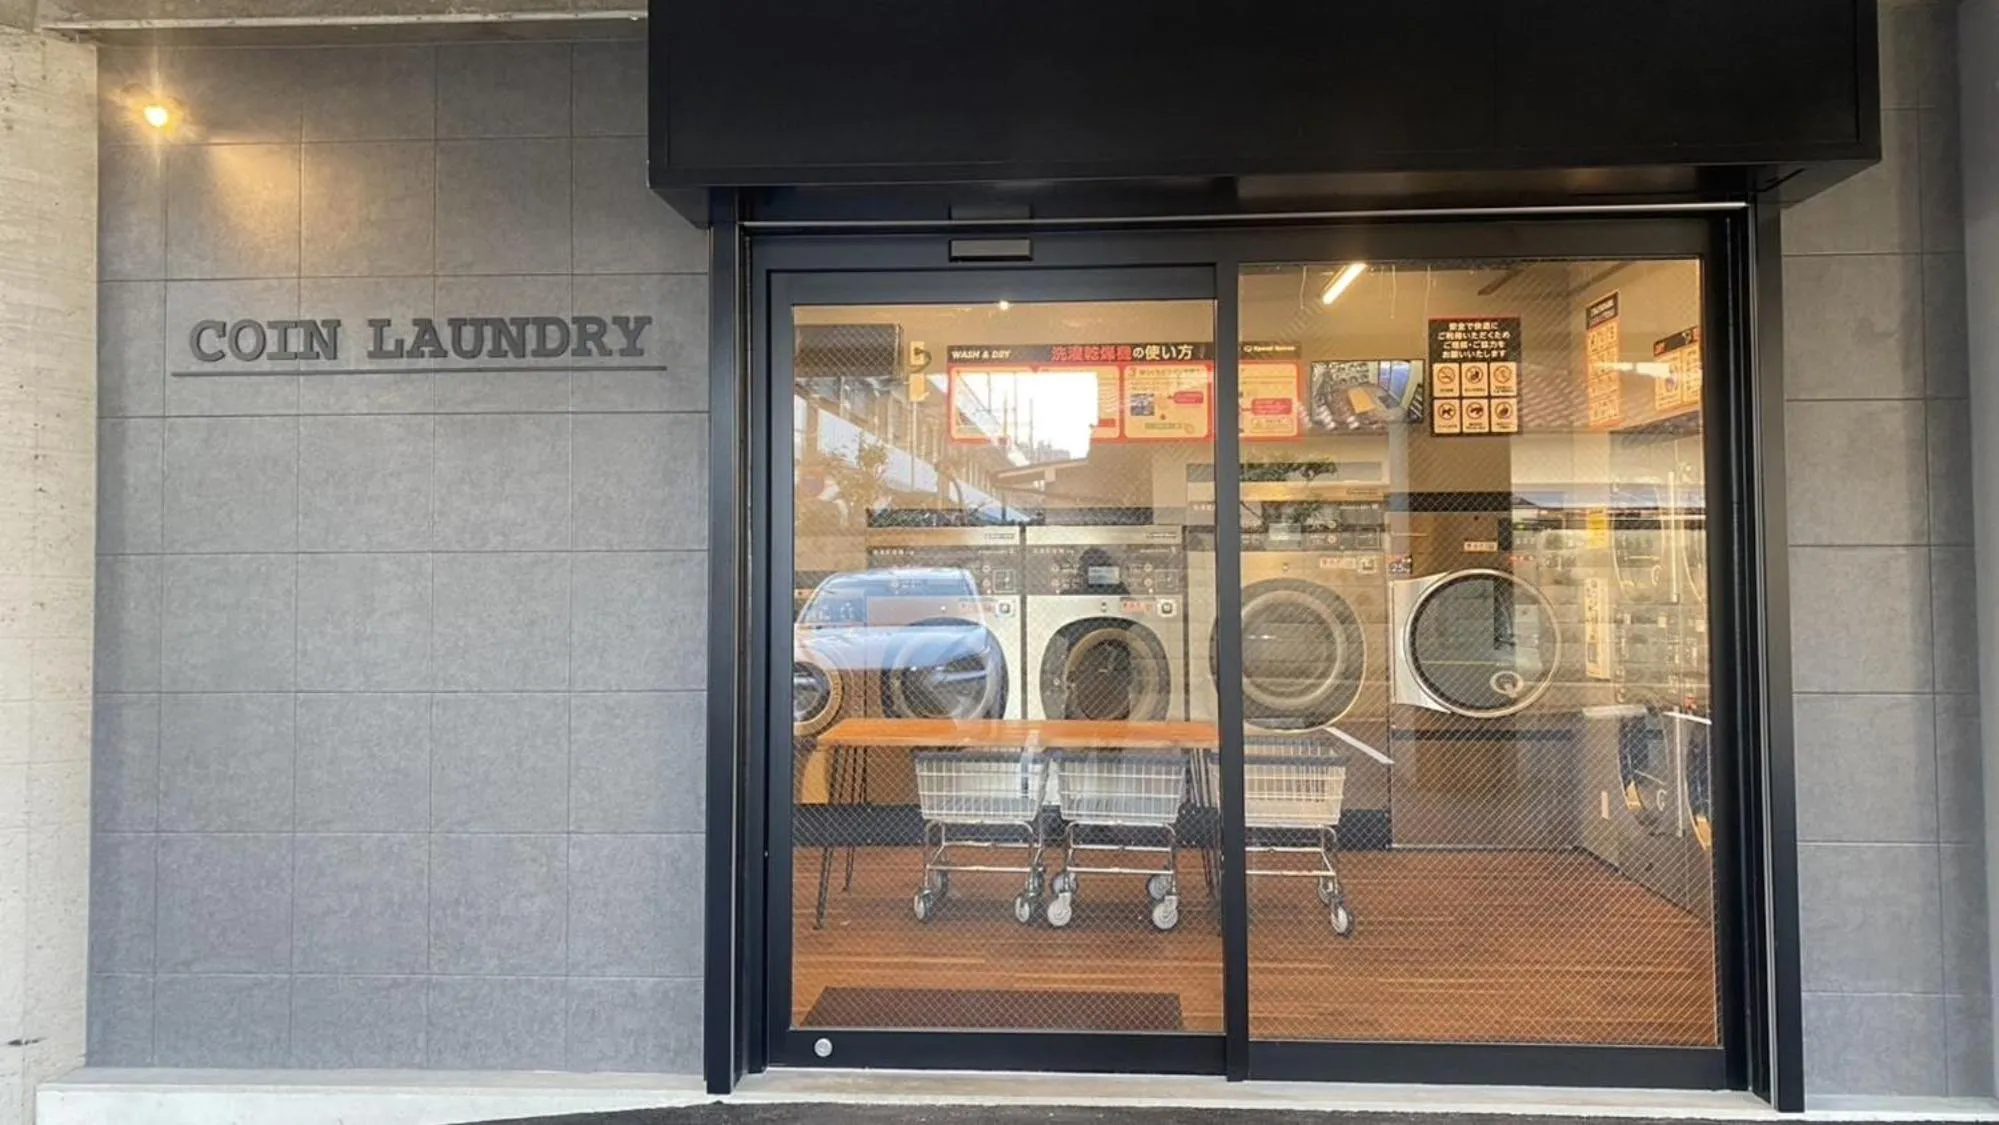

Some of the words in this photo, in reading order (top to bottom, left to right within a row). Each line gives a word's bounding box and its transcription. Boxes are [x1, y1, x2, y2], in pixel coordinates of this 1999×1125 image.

[189, 318, 341, 362] COIN
[367, 315, 653, 360] LAUNDRY
[952, 351, 981, 359] WASH
[991, 350, 1012, 359] DRY
